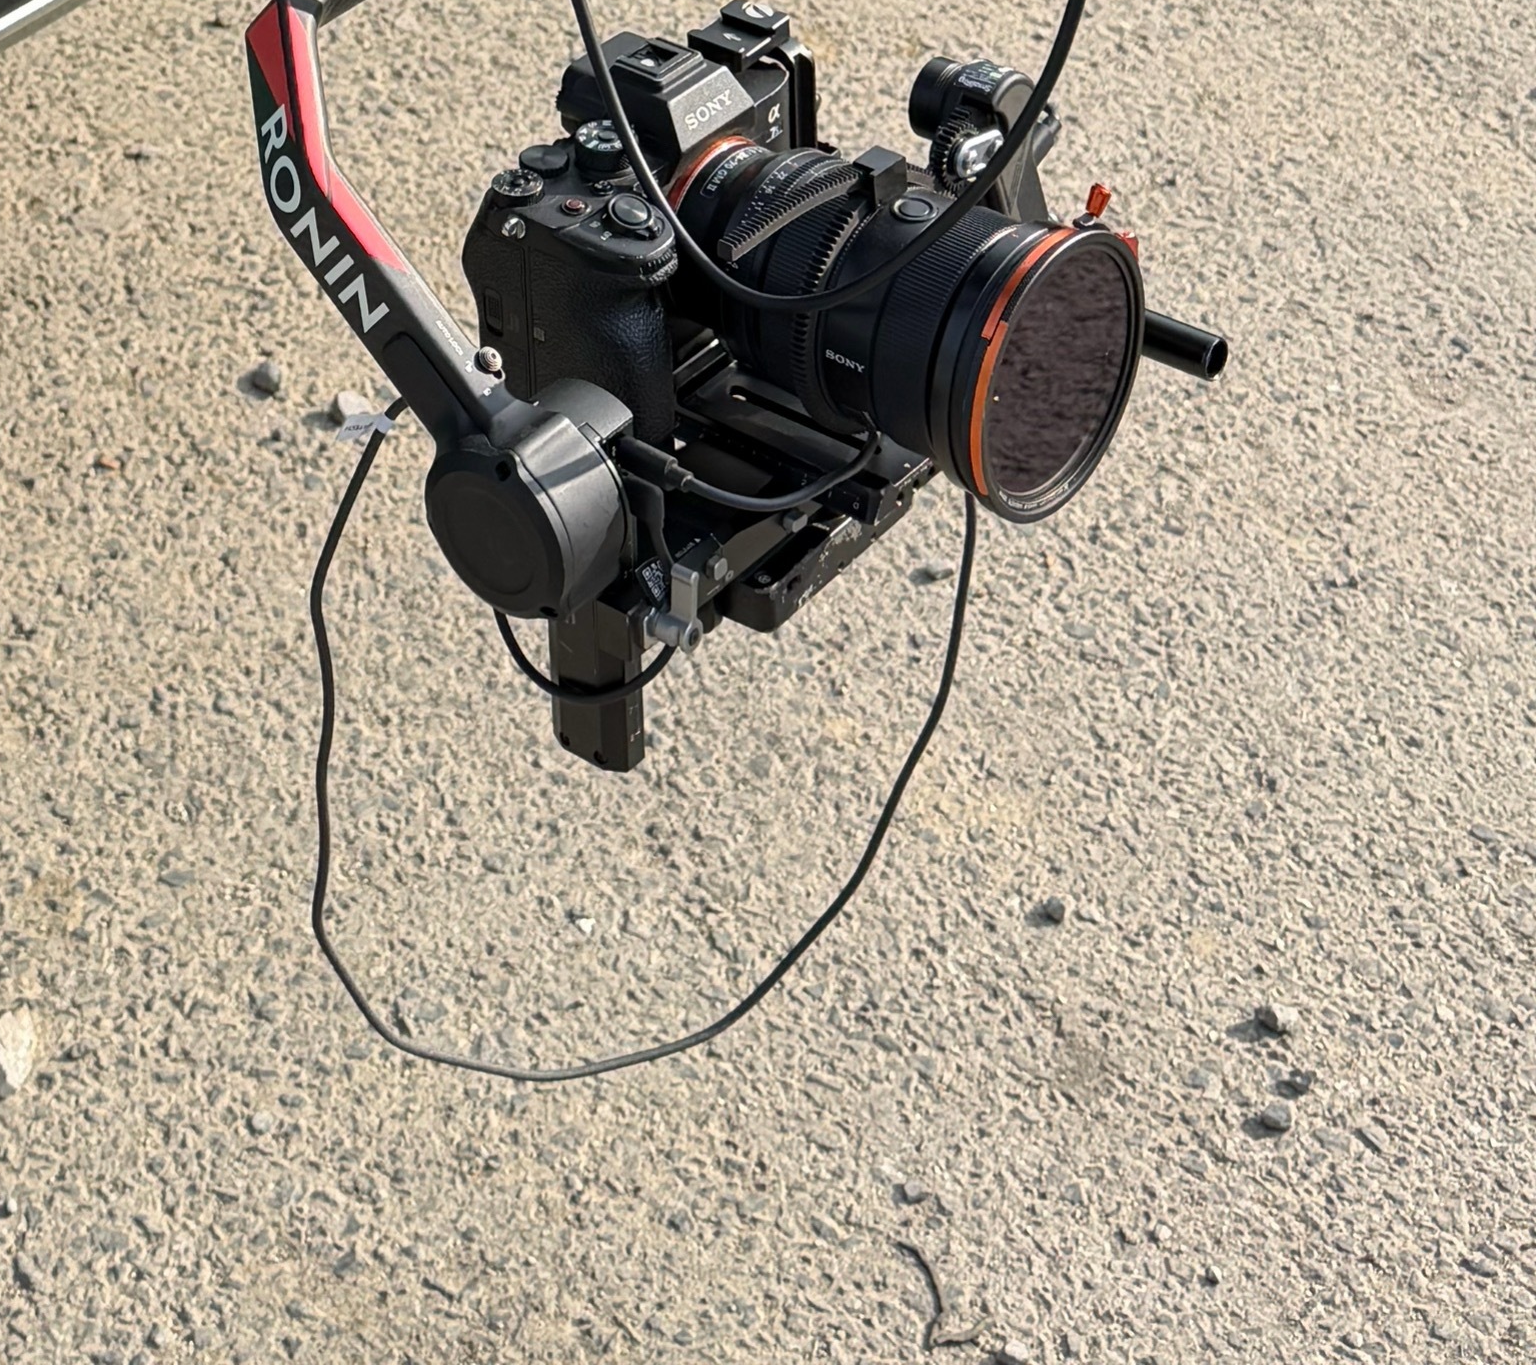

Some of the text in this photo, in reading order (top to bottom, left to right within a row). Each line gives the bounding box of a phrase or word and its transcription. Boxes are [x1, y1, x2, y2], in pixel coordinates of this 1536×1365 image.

[684, 88, 734, 131] SONY
[260, 102, 391, 334] RONIN
[825, 348, 866, 373] SONY
